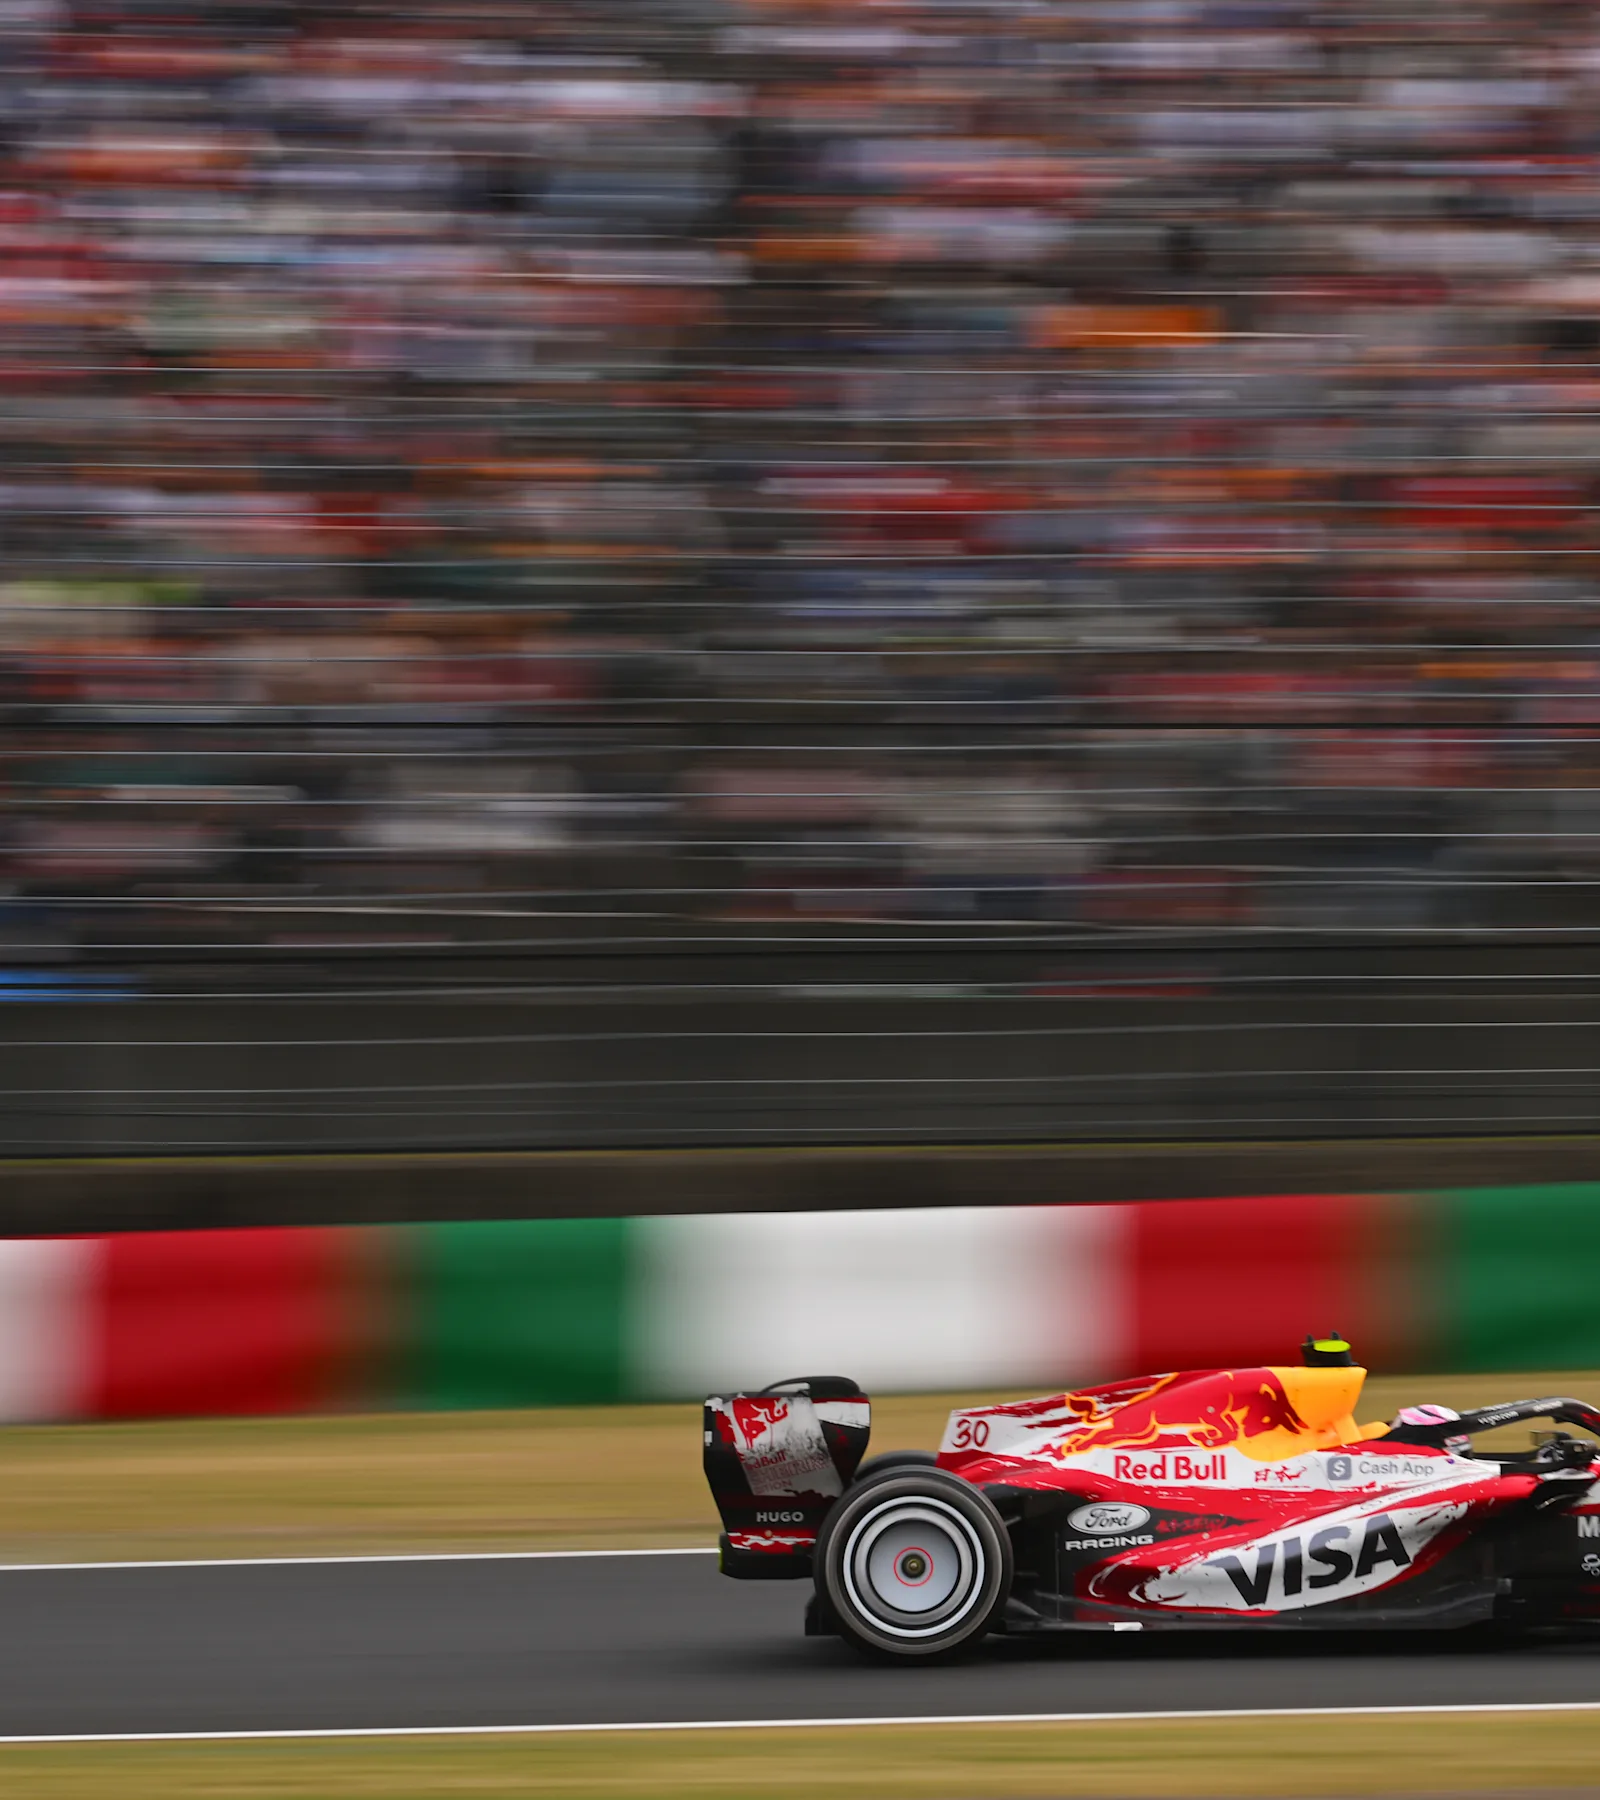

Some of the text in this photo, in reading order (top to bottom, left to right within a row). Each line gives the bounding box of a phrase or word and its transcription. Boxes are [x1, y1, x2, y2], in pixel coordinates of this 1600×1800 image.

[951, 1419, 990, 1448] 30
[1114, 1455, 1226, 1480] Red Bull
[1359, 1461, 1398, 1475] Cash
[1402, 1461, 1434, 1477] App
[756, 1511, 804, 1523] HUGO
[1085, 1507, 1132, 1528] Ford
[1065, 1534, 1154, 1551] RACING
[1201, 1513, 1411, 1606] VISA
